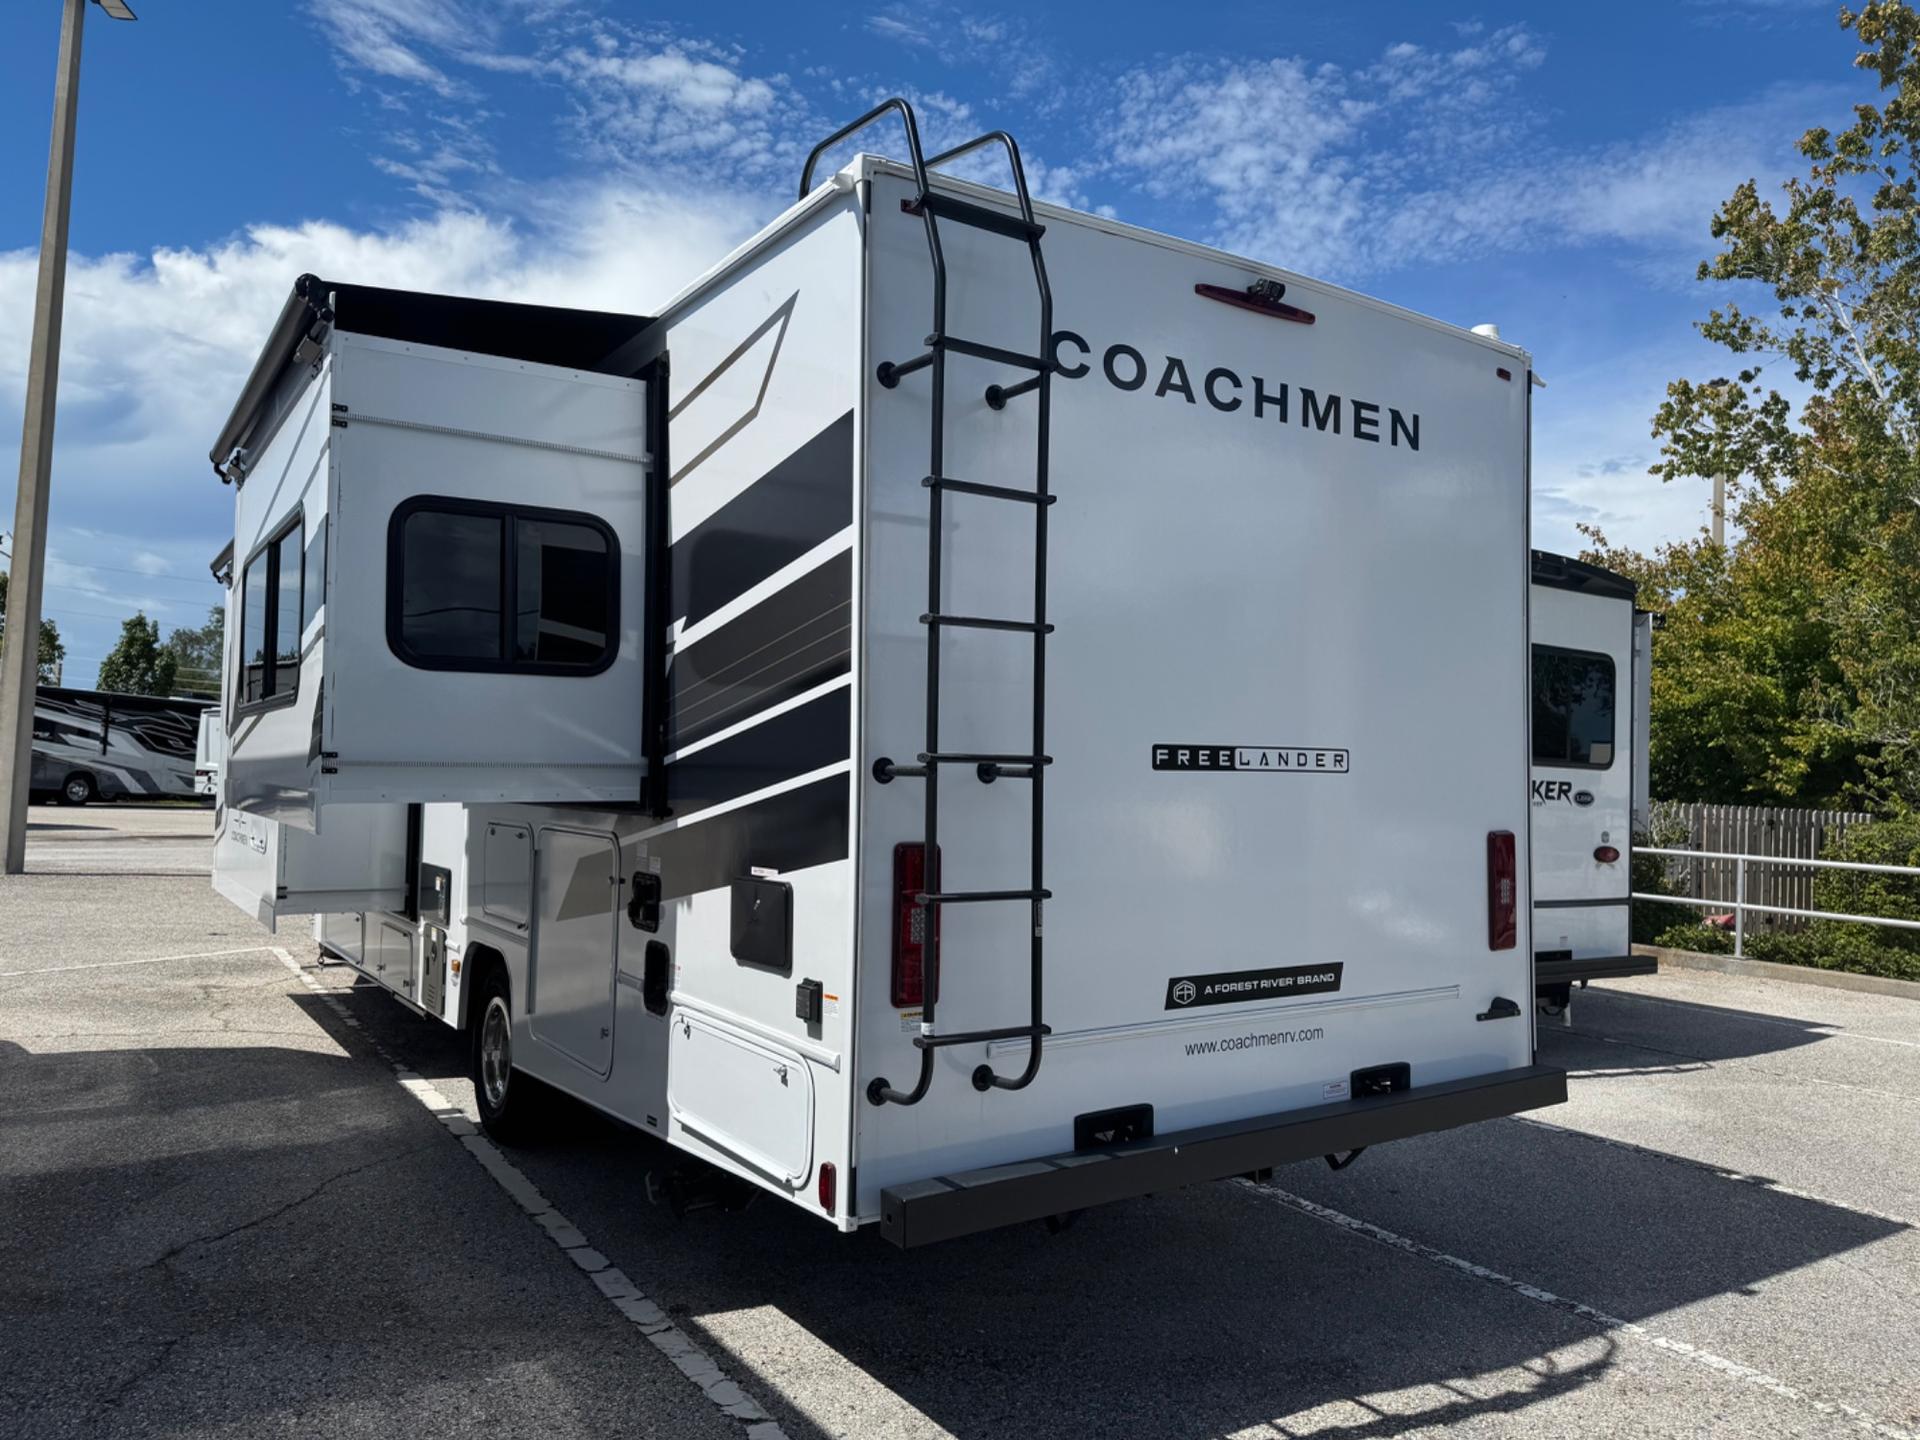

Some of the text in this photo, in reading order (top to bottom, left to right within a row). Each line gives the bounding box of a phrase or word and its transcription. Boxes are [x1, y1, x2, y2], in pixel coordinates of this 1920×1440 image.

[1050, 330, 1420, 451] COACHMEN
[1155, 749, 1345, 768] FREELANDER
[1204, 985, 1213, 995] A
[1215, 980, 1259, 994] FOREST
[1297, 973, 1335, 985] BRAND
[1184, 1026, 1324, 1056] www.coachmenrv.com
